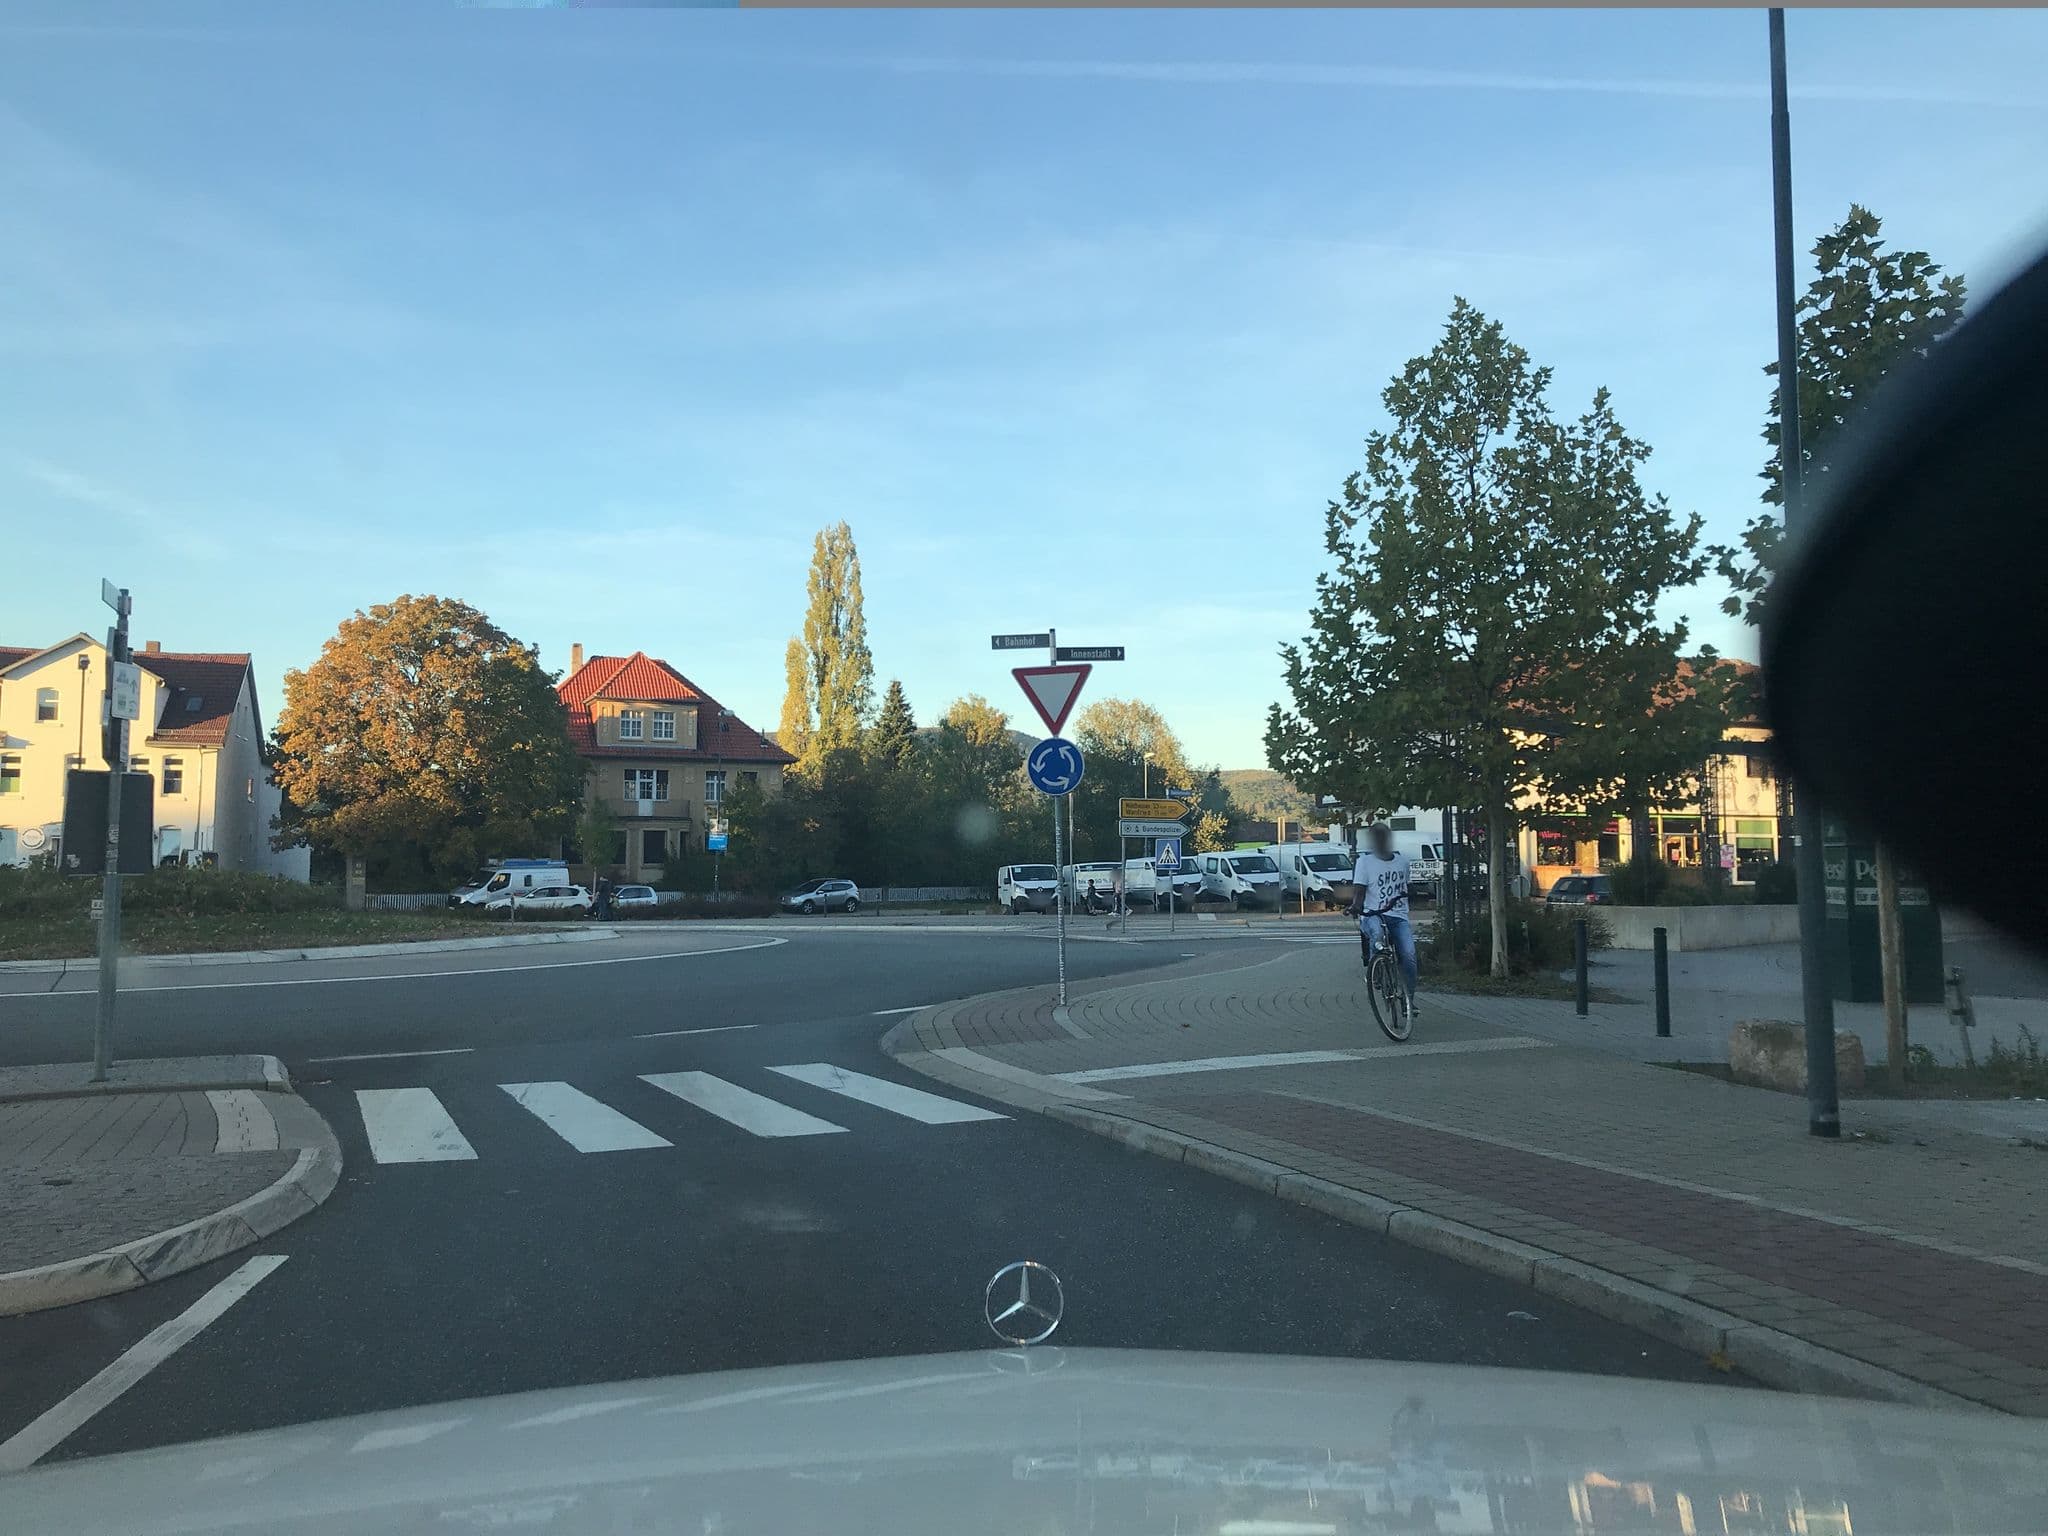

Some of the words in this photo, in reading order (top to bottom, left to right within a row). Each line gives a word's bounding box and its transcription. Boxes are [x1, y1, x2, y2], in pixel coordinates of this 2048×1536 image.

[1004, 636, 1036, 647] Bahnhof
[1070, 649, 1112, 659] Innenstadt
[1142, 825, 1182, 834] Bundespolizei
[1378, 871, 1405, 887] SHOW
